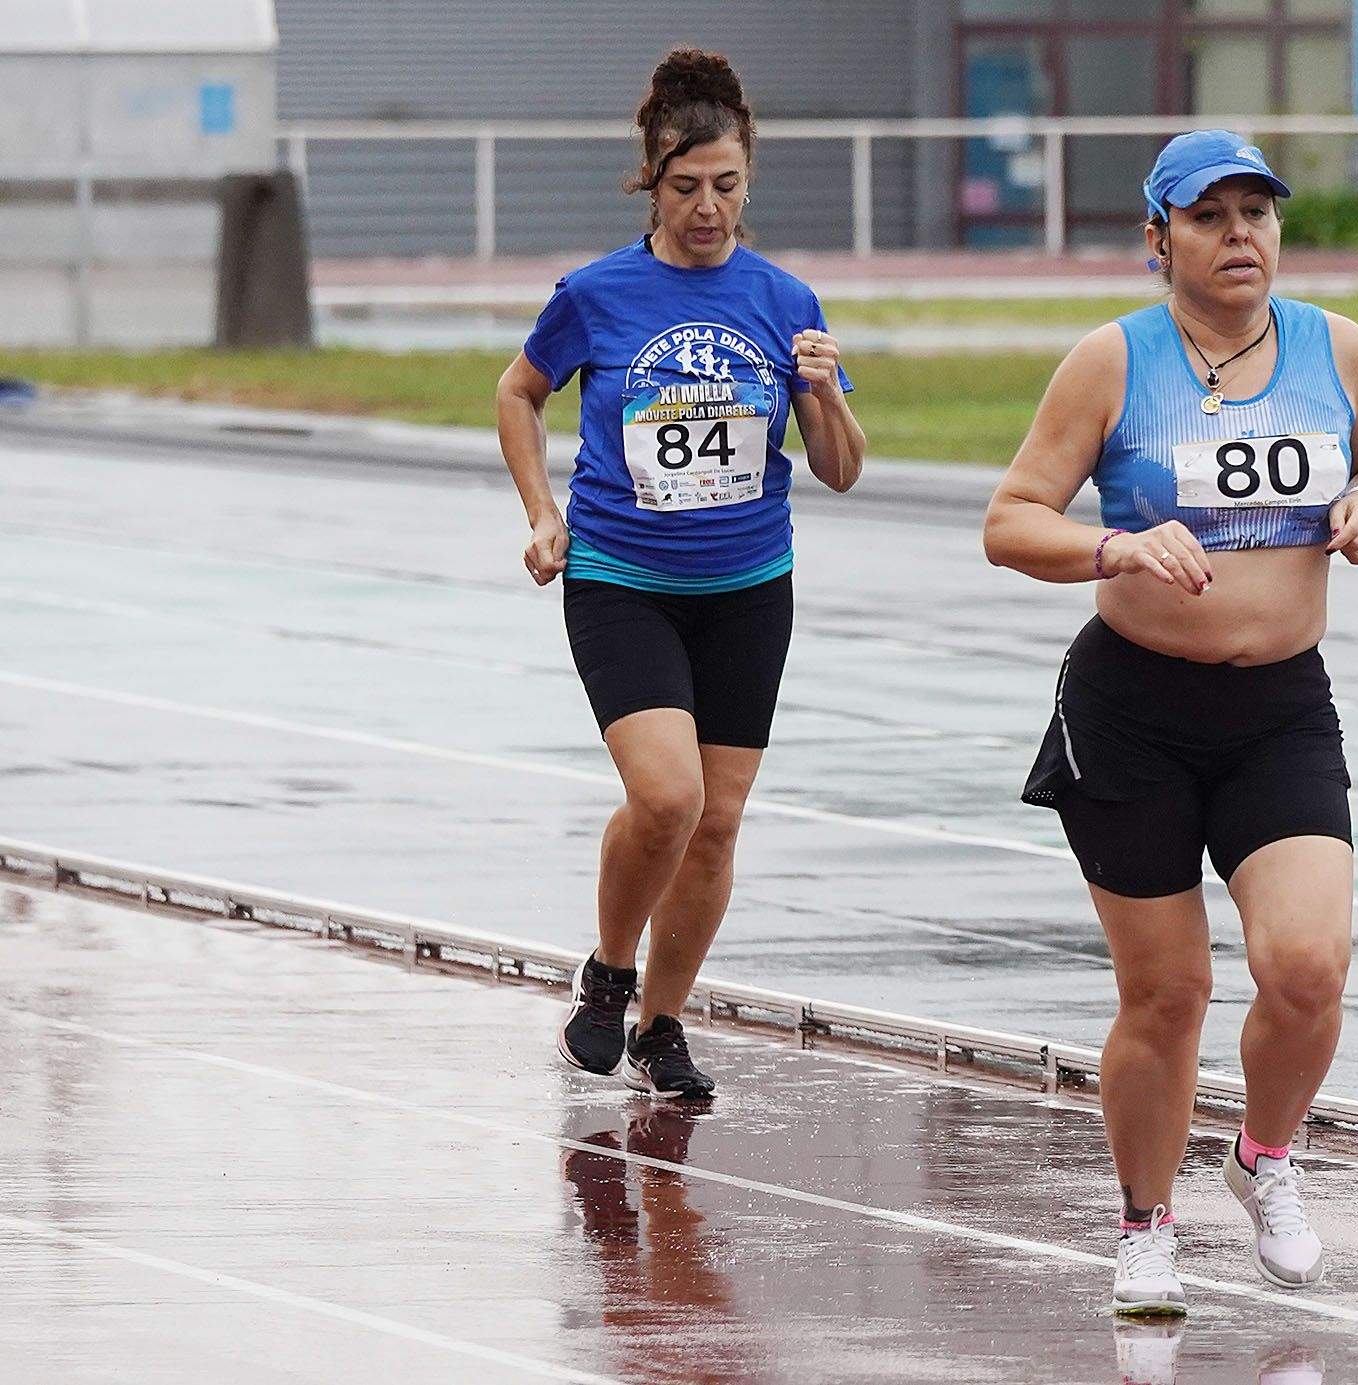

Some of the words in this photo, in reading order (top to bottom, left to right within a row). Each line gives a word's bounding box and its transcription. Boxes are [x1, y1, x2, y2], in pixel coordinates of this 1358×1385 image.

[671, 328, 715, 346] POLA
[659, 386, 677, 405] XI
[681, 383, 734, 404] MILLA
[679, 405, 706, 420] POLA
[707, 404, 756, 418] DIABETES
[657, 421, 735, 469] 84
[1216, 438, 1310, 498] 80
